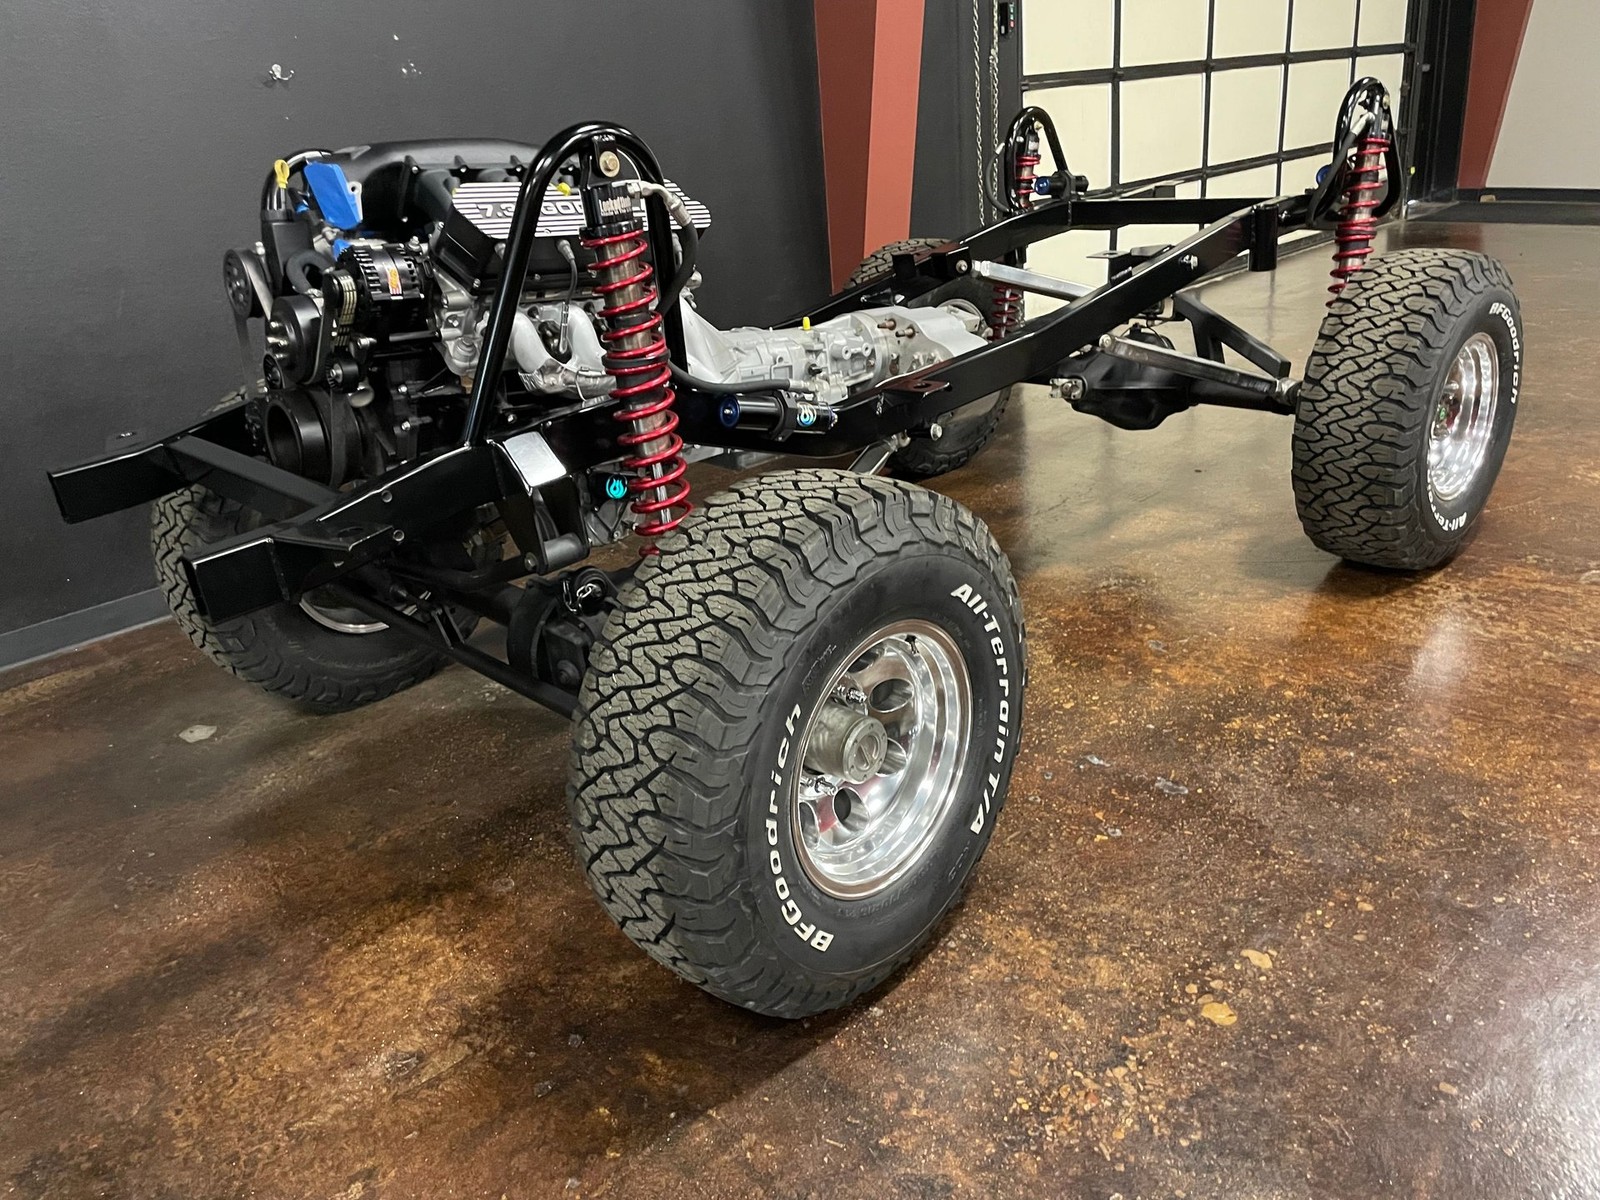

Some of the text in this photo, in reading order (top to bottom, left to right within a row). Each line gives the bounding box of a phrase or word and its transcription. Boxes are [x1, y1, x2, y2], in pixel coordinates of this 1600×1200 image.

[950, 583, 1010, 764] All-Terrain
[765, 703, 835, 952] BFGoodrich
[969, 772, 1001, 835] T/A
